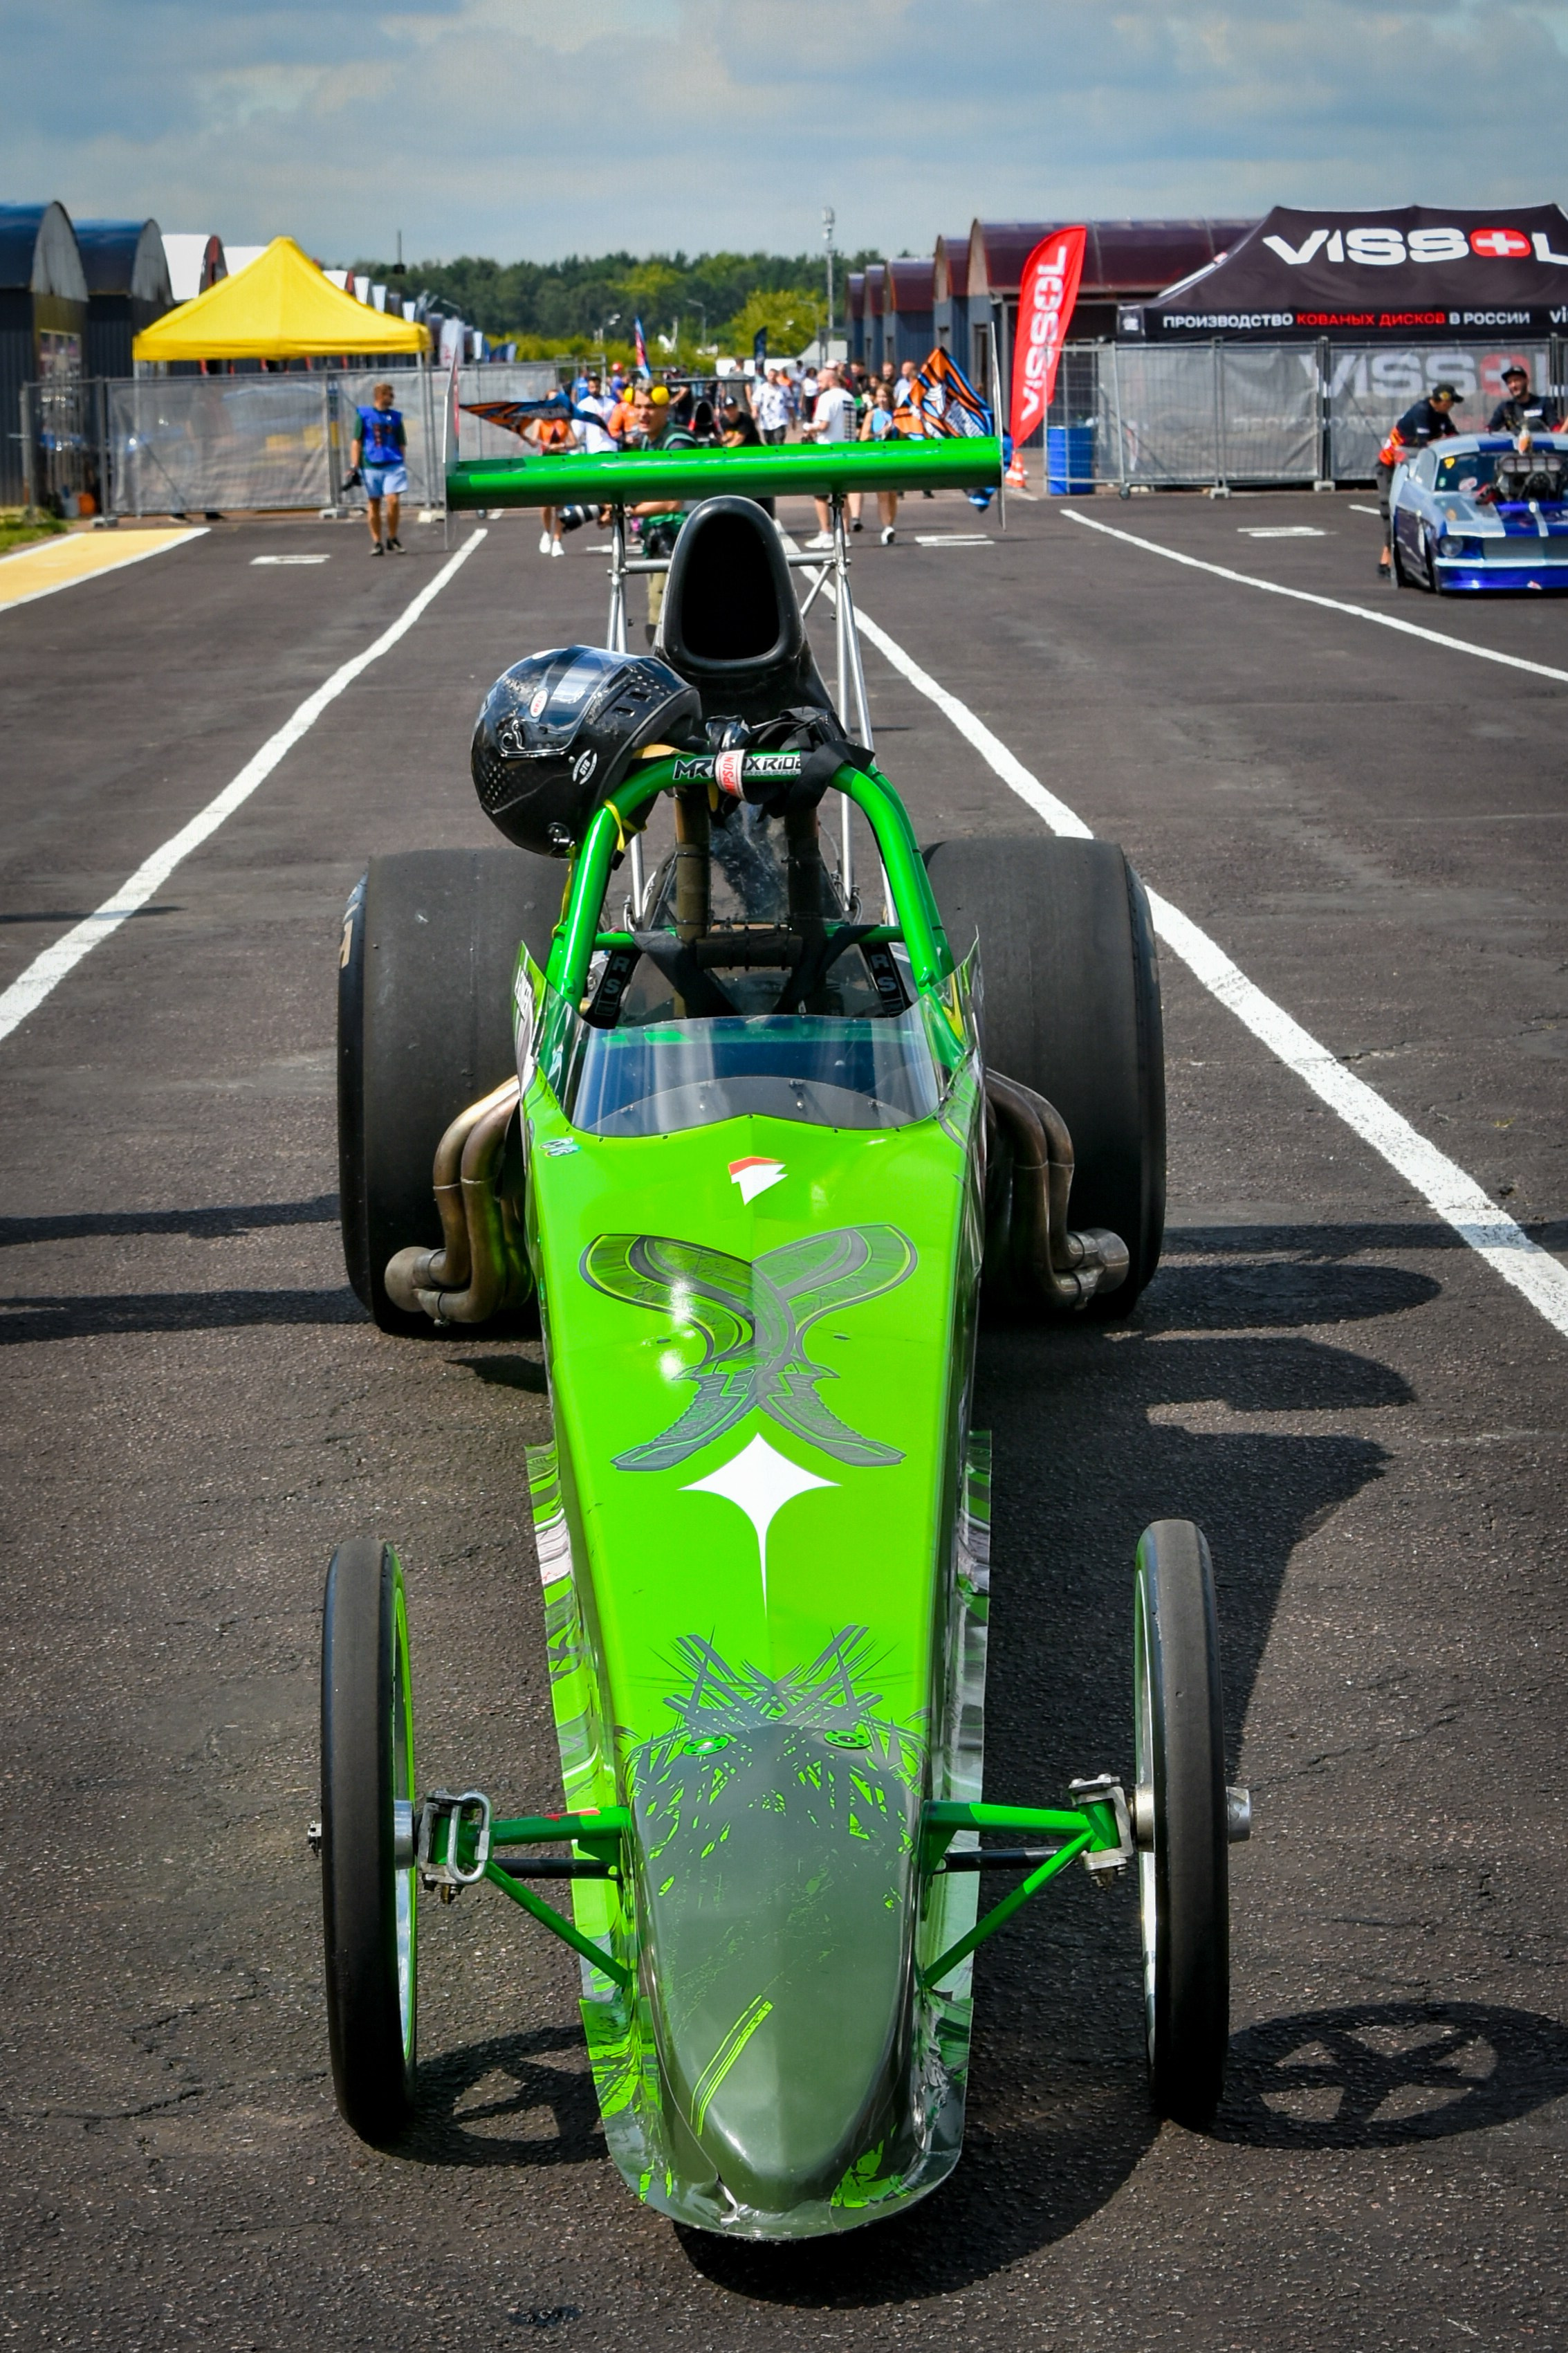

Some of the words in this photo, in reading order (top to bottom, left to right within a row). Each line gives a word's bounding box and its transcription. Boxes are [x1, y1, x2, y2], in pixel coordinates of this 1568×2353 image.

[1163, 313, 1293, 329] ПРОИЗВОДСТВО
[1297, 312, 1375, 326] КОВАНЫХ
[1378, 311, 1446, 328] ДИСКОВ
[1449, 311, 1461, 325] В
[1463, 311, 1531, 325] РОССИИ
[1549, 305, 1568, 324] vi
[720, 756, 737, 795] MPSON
